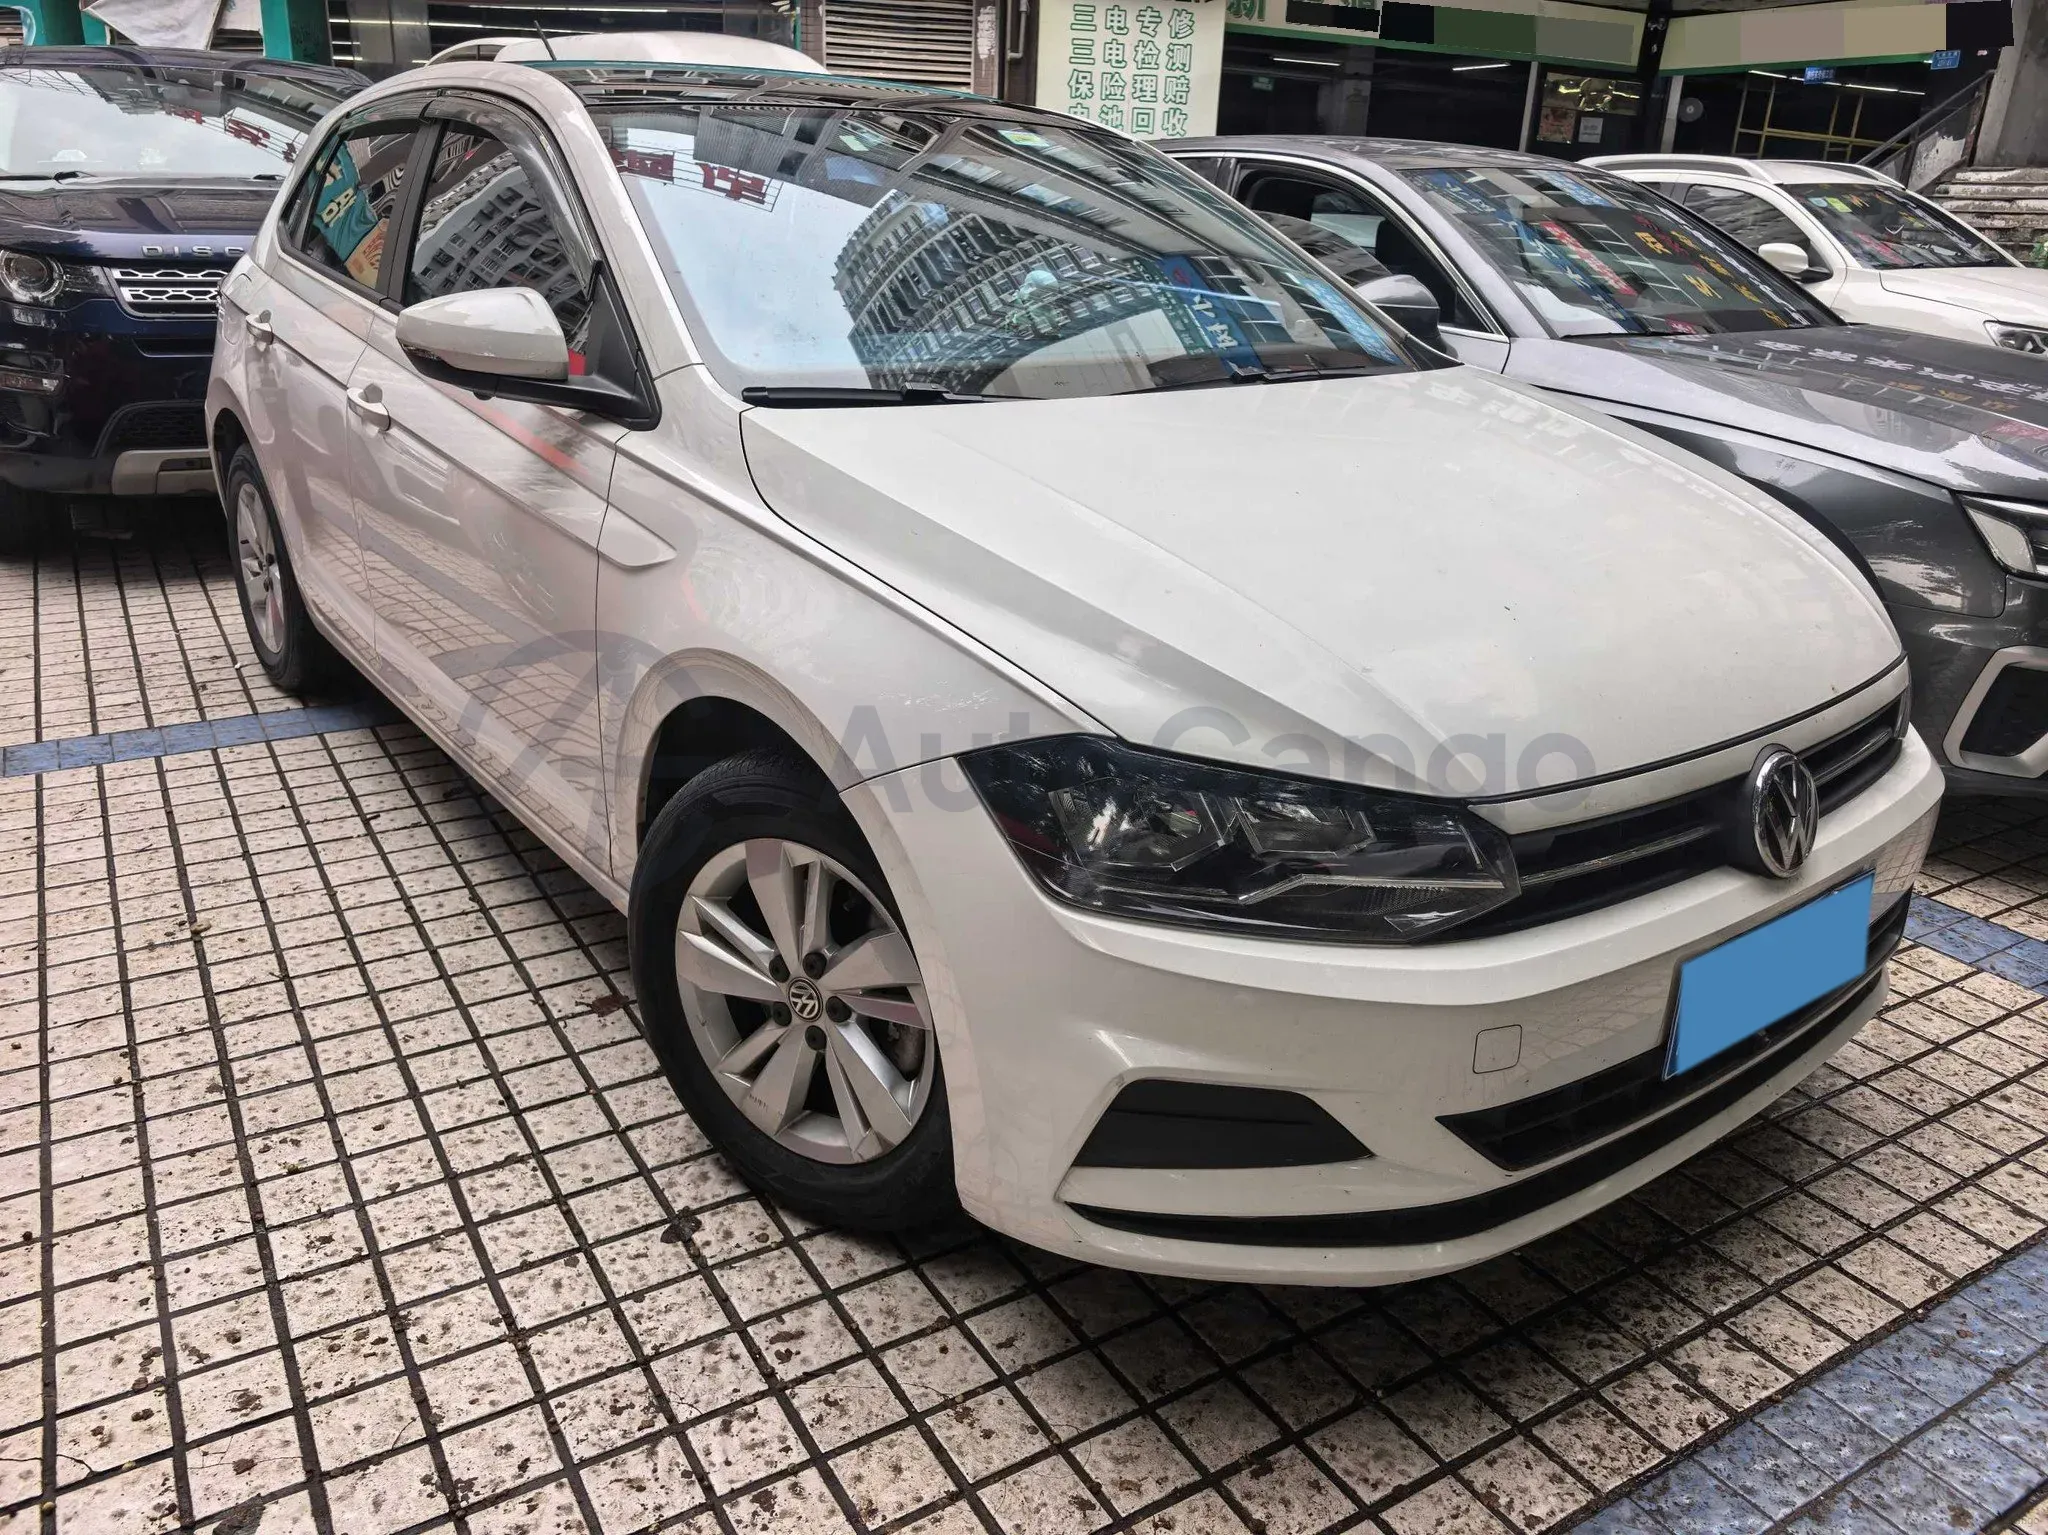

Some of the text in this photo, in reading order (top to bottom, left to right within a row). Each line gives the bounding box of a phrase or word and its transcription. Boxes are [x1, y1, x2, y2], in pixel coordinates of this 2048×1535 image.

[1070, 4, 1195, 40] 三电专修
[1069, 38, 1193, 73] 三电检测
[1067, 69, 1190, 105] 保险理赔
